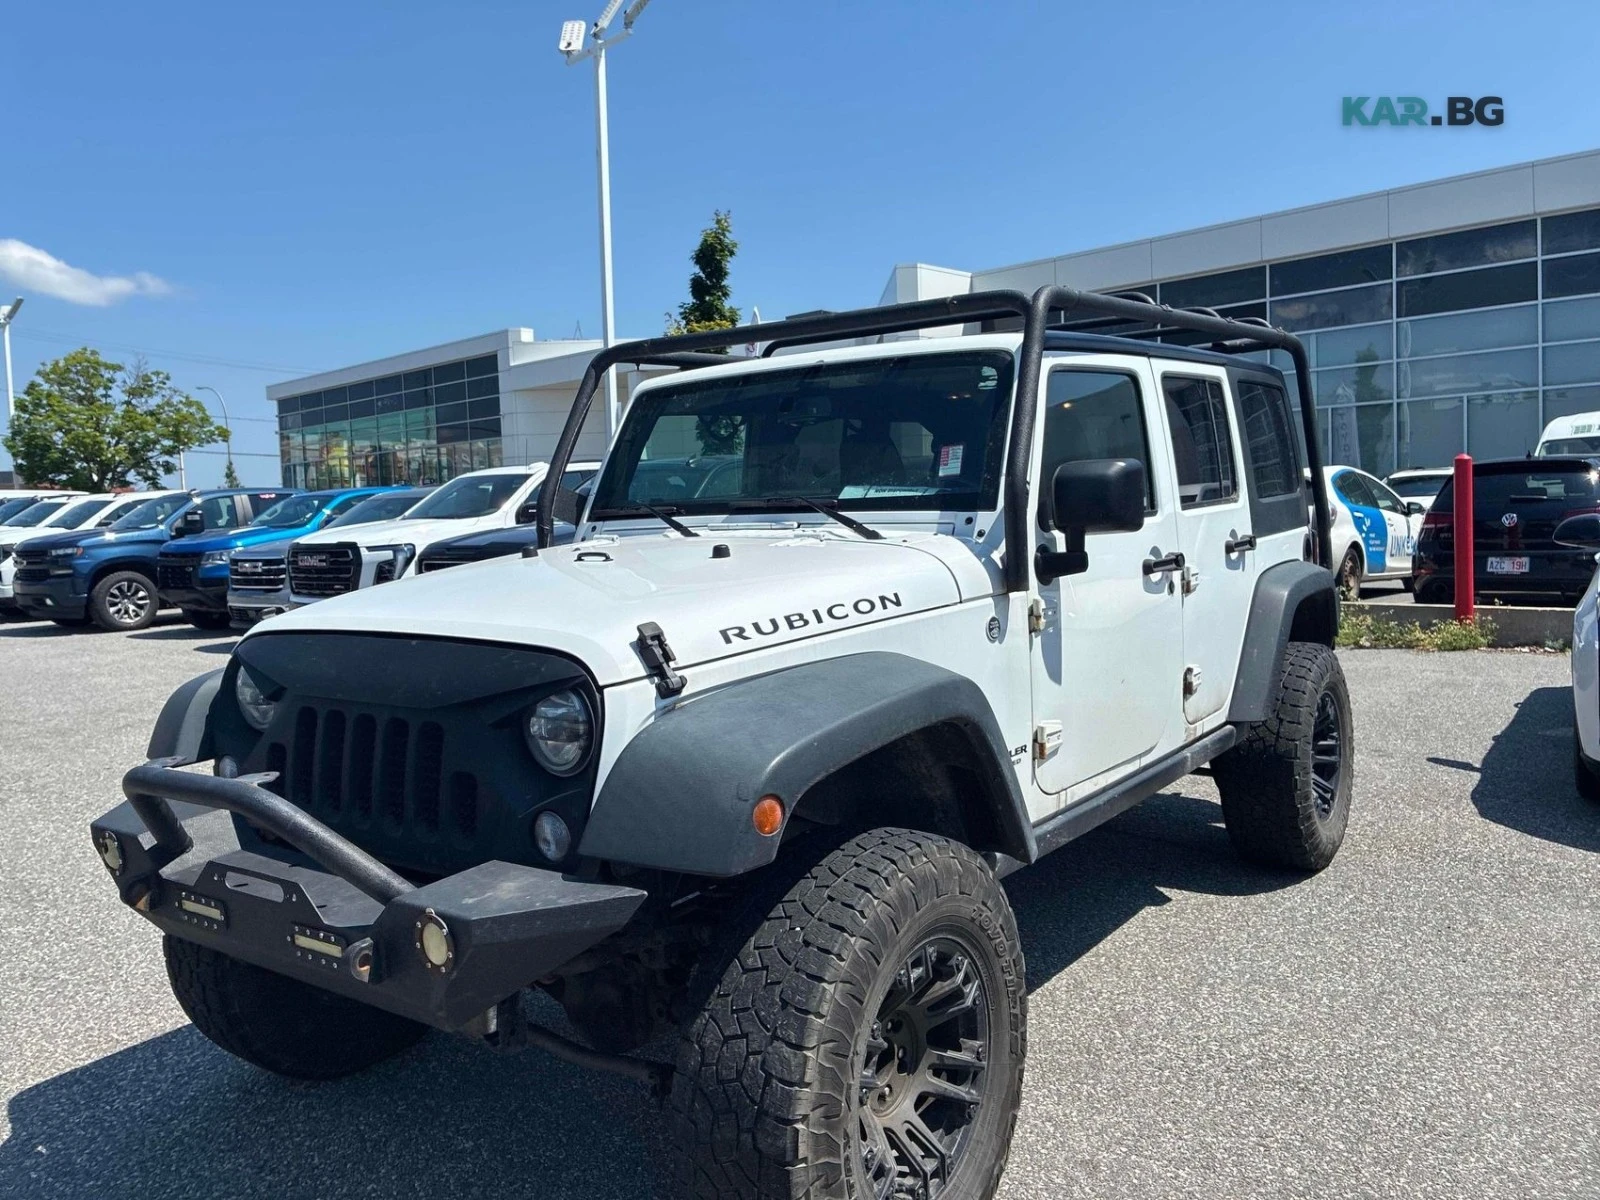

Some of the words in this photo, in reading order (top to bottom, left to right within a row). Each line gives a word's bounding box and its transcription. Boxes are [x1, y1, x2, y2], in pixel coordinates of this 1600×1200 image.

[298, 555, 327, 567] GMC
[719, 592, 902, 645] RUBICON
[1009, 744, 1027, 757] LER
